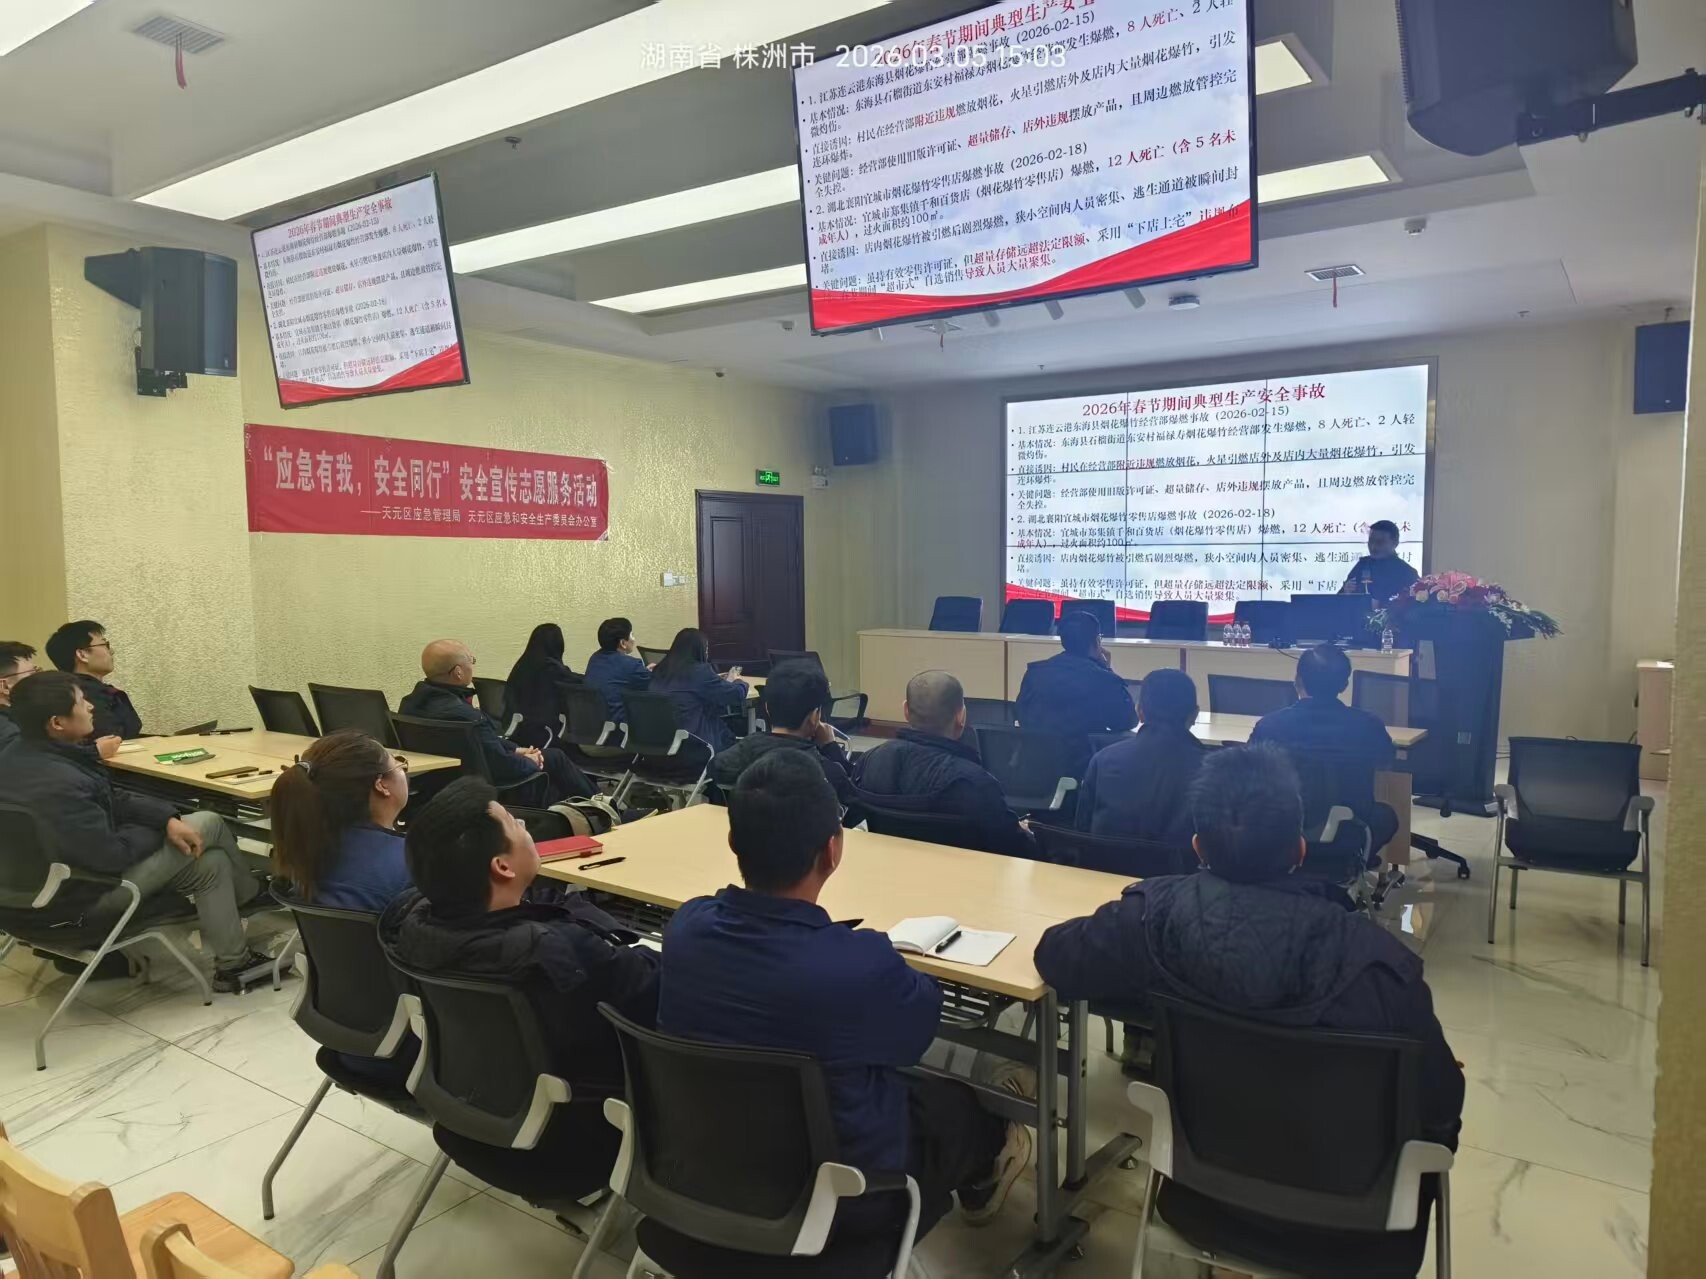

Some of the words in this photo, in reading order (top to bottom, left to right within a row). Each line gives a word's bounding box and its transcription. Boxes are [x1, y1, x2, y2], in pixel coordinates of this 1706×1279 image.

[1082, 382, 1326, 416] 2026年春节期间典型生产安全事故
